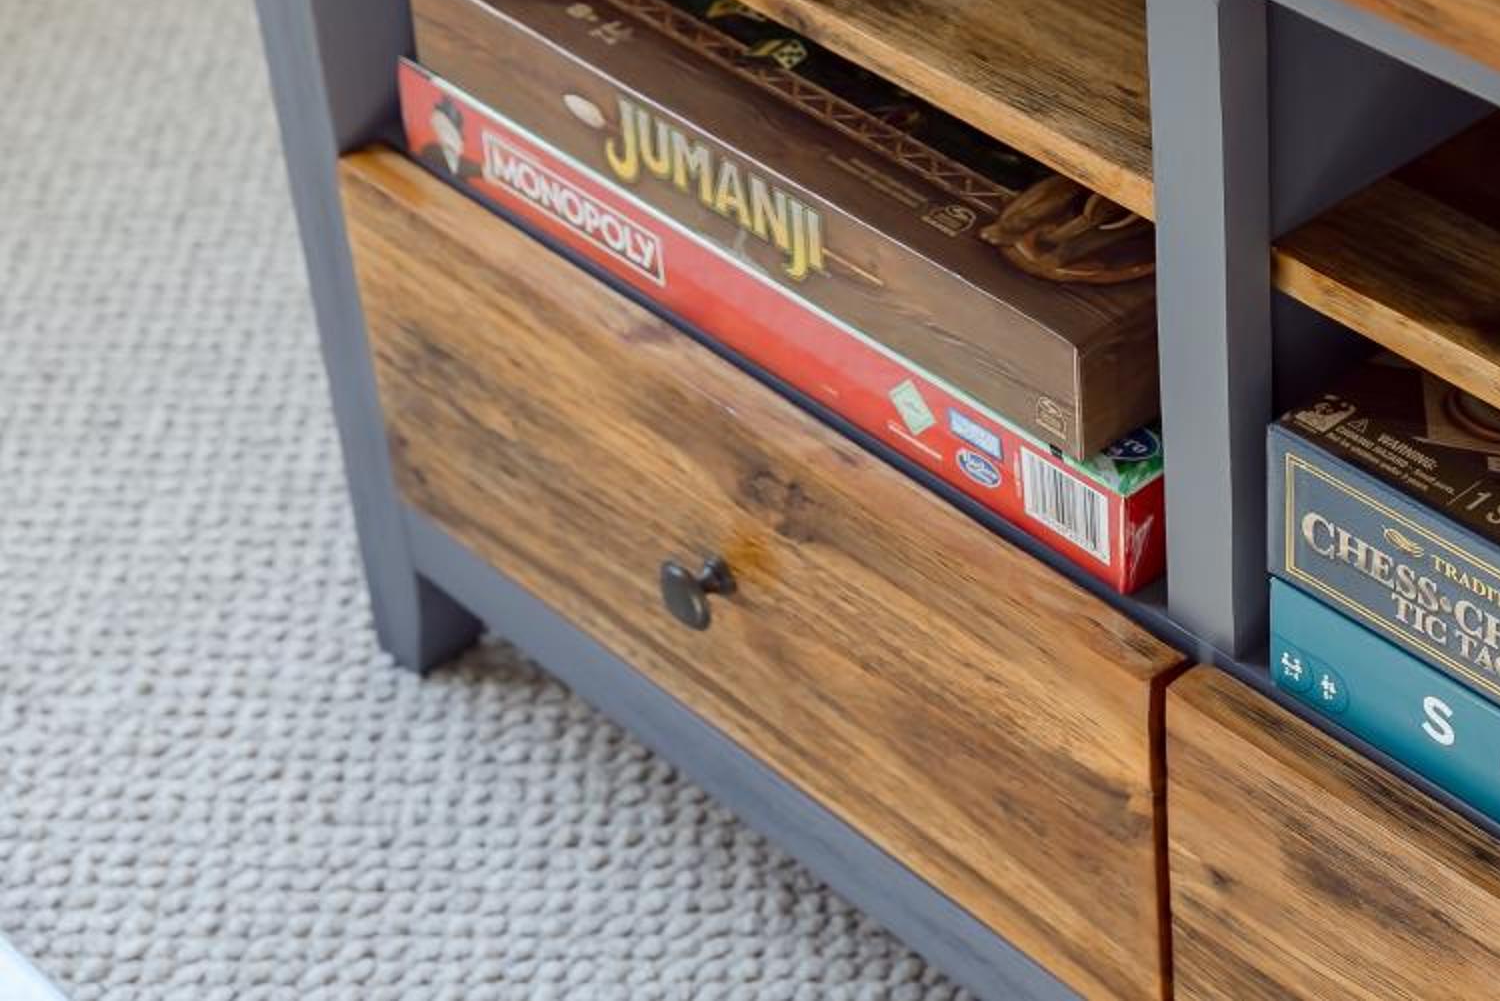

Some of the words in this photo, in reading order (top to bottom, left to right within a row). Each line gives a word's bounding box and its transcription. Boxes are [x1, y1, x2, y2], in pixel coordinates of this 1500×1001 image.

[492, 146, 654, 269] MONOPOLY
[606, 95, 824, 281] JUMANJI
[1466, 490, 1493, 511] 1
[1301, 512, 1439, 612] CHESS
[1391, 592, 1447, 645] TIC
